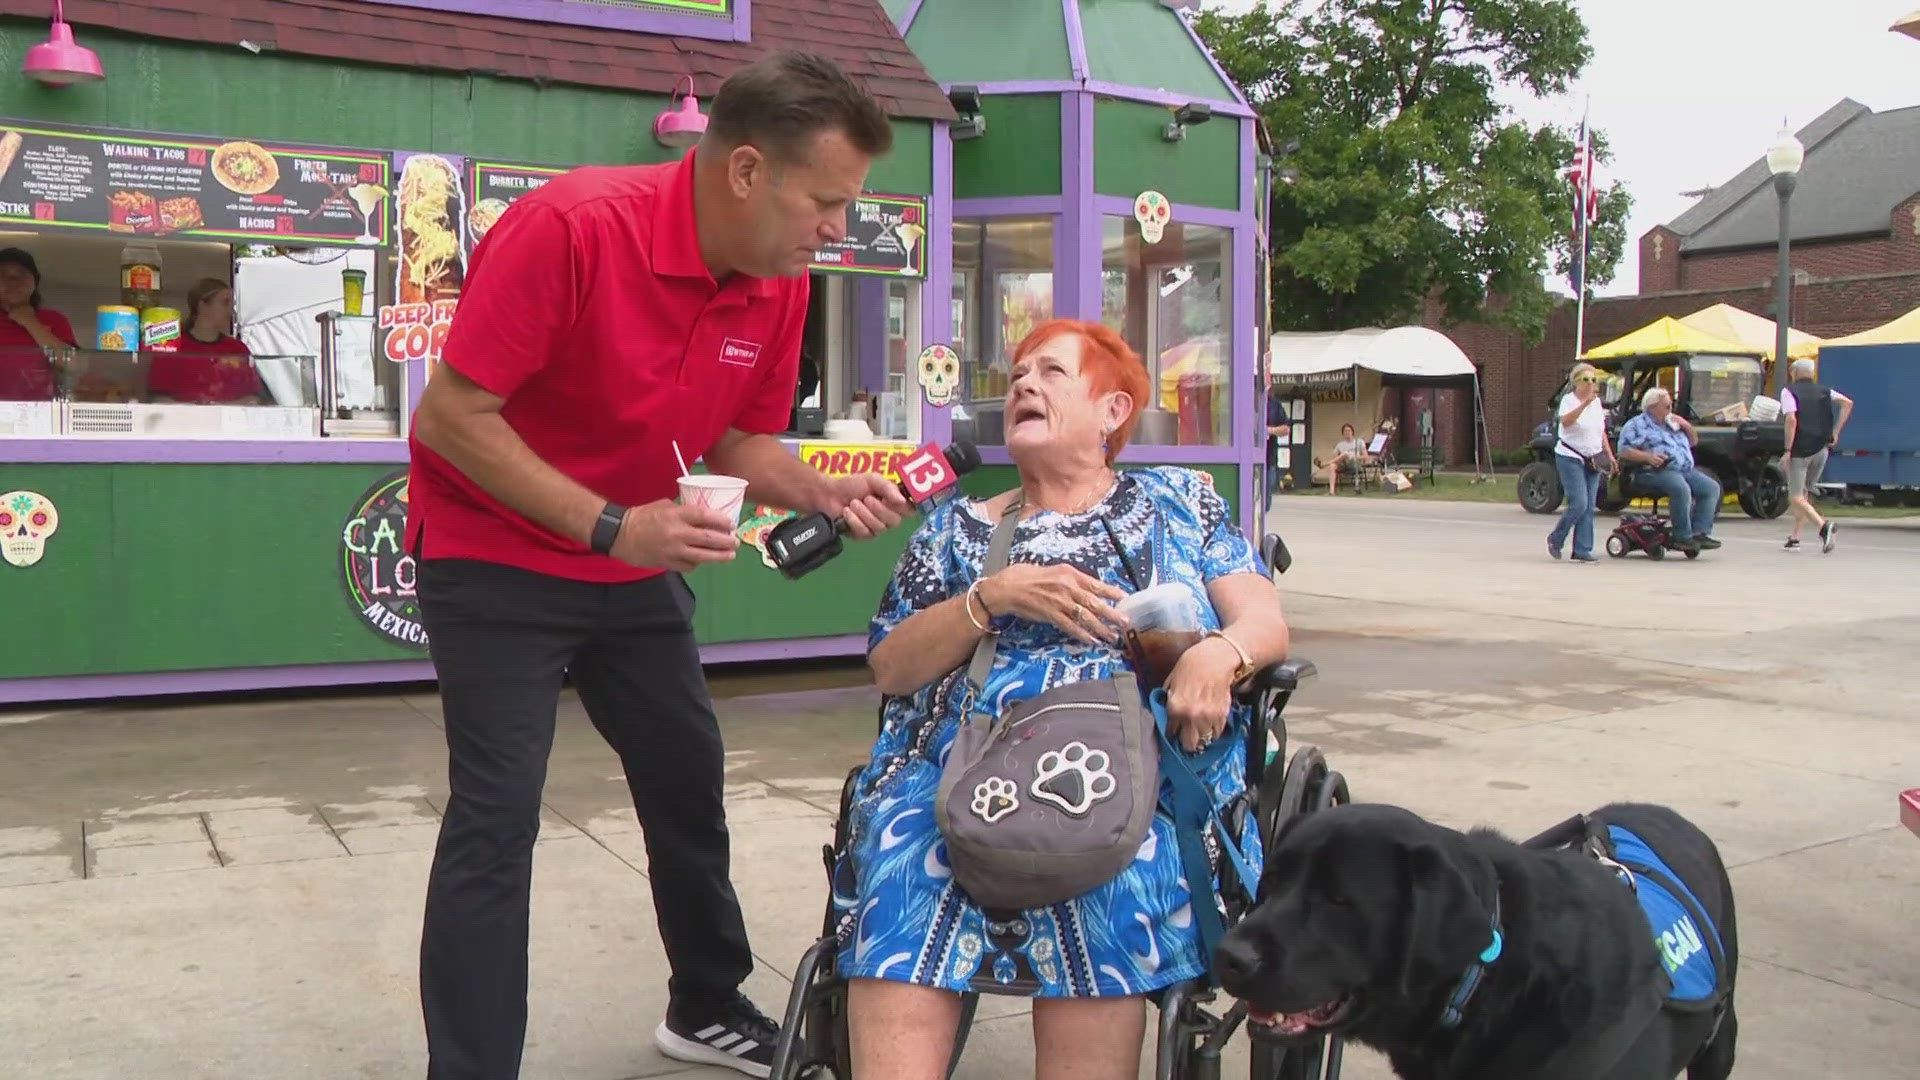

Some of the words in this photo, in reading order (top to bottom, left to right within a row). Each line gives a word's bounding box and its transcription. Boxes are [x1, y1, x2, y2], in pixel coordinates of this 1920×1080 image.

[102, 143, 149, 158] WALKING
[152, 147, 186, 160] TACOS
[108, 162, 132, 171] DORITOS
[294, 159, 327, 172] FROZEN
[489, 175, 525, 187] BURRITO
[0, 201, 30, 216] STICK
[239, 216, 275, 229] NACHOS
[815, 251, 841, 263] NACHOS
[380, 303, 430, 328] DEEP
[433, 299, 457, 323] FR
[386, 321, 451, 361] COR
[1272, 375, 1297, 384] ATURE
[809, 450, 907, 476] ORDER
[902, 452, 945, 493] 13
[344, 517, 408, 554] CA
[370, 555, 417, 596] LO
[362, 601, 430, 644] MEXICA
